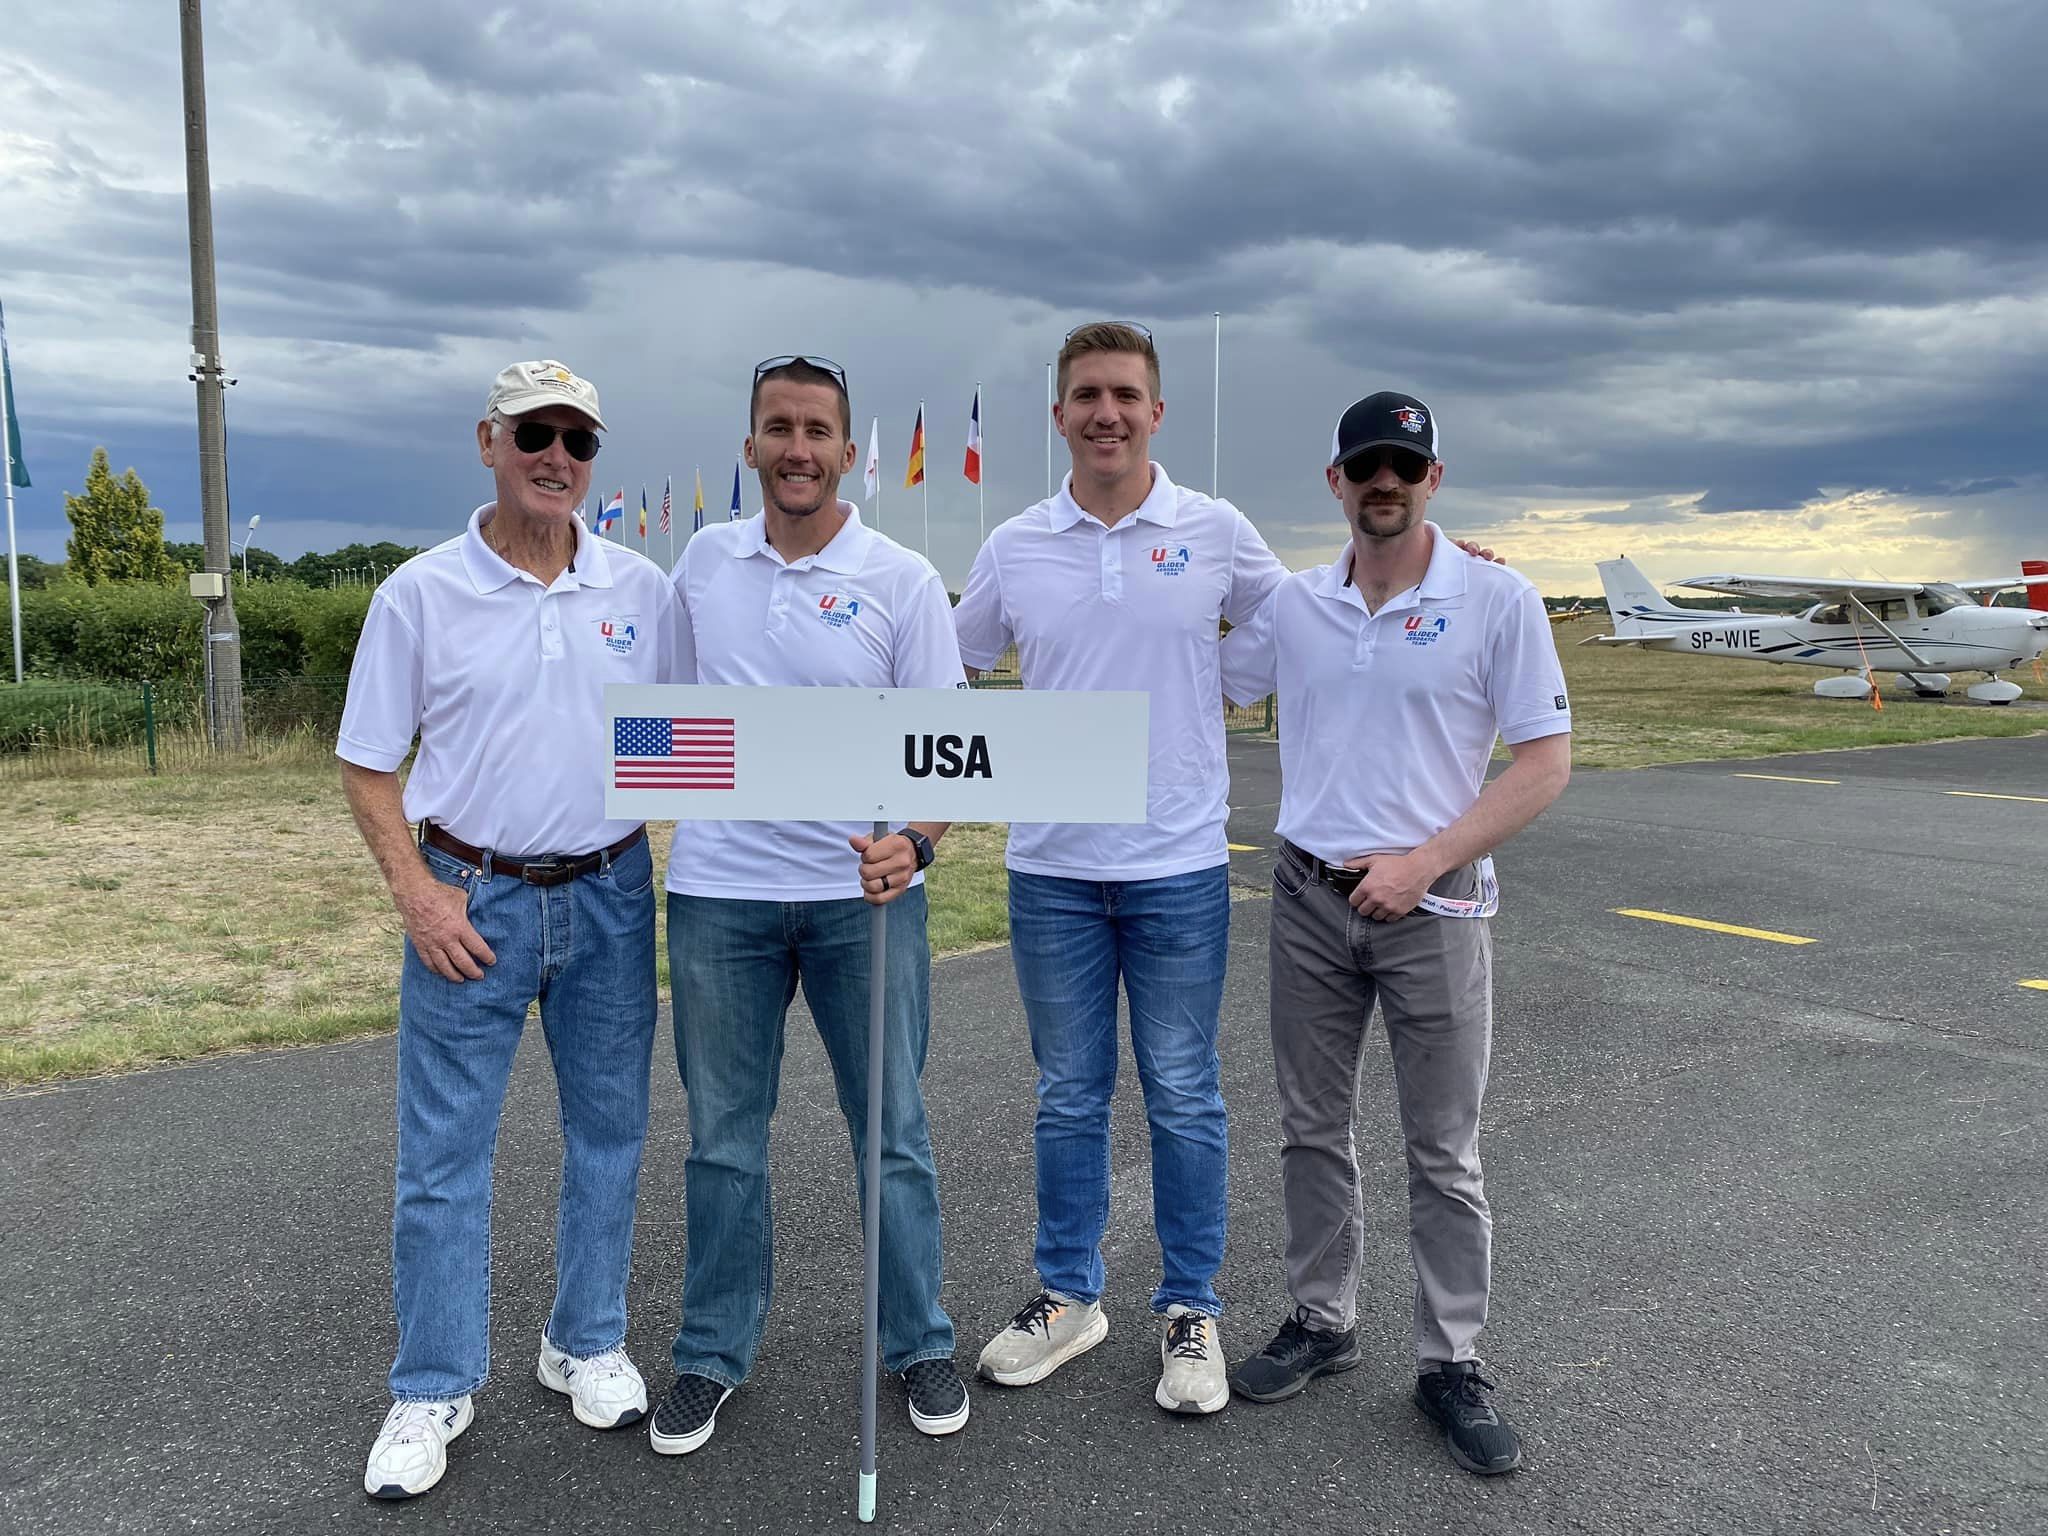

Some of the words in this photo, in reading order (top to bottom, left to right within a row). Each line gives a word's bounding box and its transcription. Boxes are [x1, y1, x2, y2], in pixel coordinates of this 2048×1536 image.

[822, 609, 852, 620] GLIDER
[1407, 630, 1439, 638] GLIDER
[1691, 629, 1761, 649] SP-WIE
[606, 637, 632, 646] GLIDER
[904, 734, 993, 779] USA
